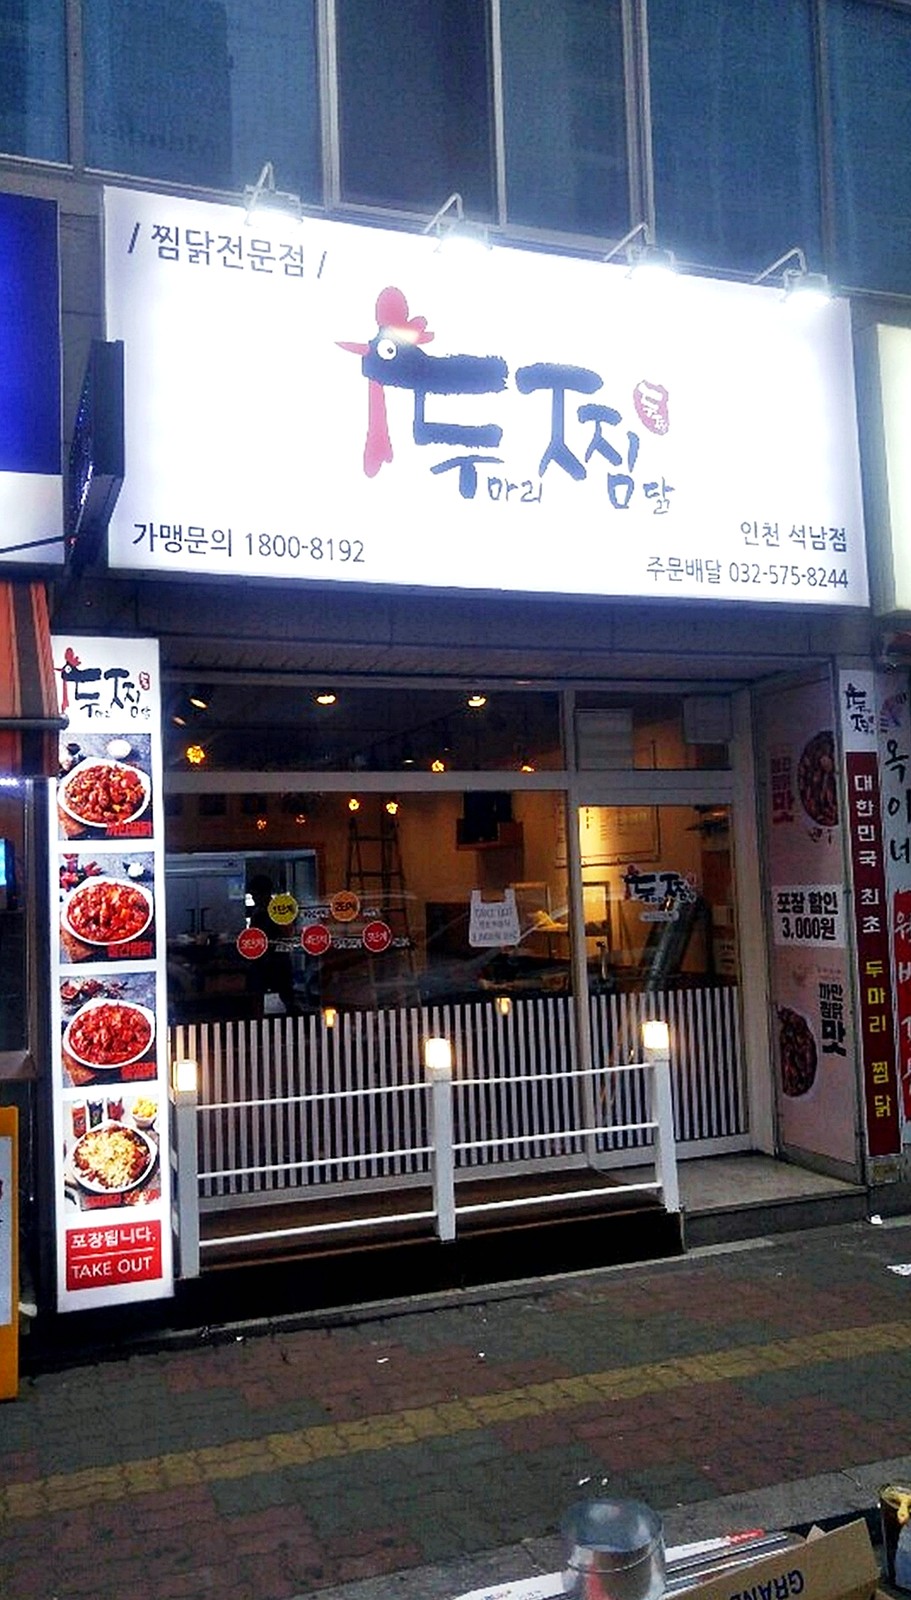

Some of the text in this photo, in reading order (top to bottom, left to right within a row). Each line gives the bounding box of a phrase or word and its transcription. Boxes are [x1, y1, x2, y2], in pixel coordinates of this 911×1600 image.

[150, 224, 304, 278] 찜닭전문점
[132, 523, 365, 563] 가맹문의 1800-8192
[740, 521, 847, 553] 인천 석남점
[646, 557, 849, 589] 주문배달 032-575-8244
[808, 891, 839, 915] 할인
[782, 917, 836, 941] 3,000원
[854, 774, 892, 1118] 대한민국 최초 두마리 찜닭
[71, 1255, 153, 1280] TAKE OUT
